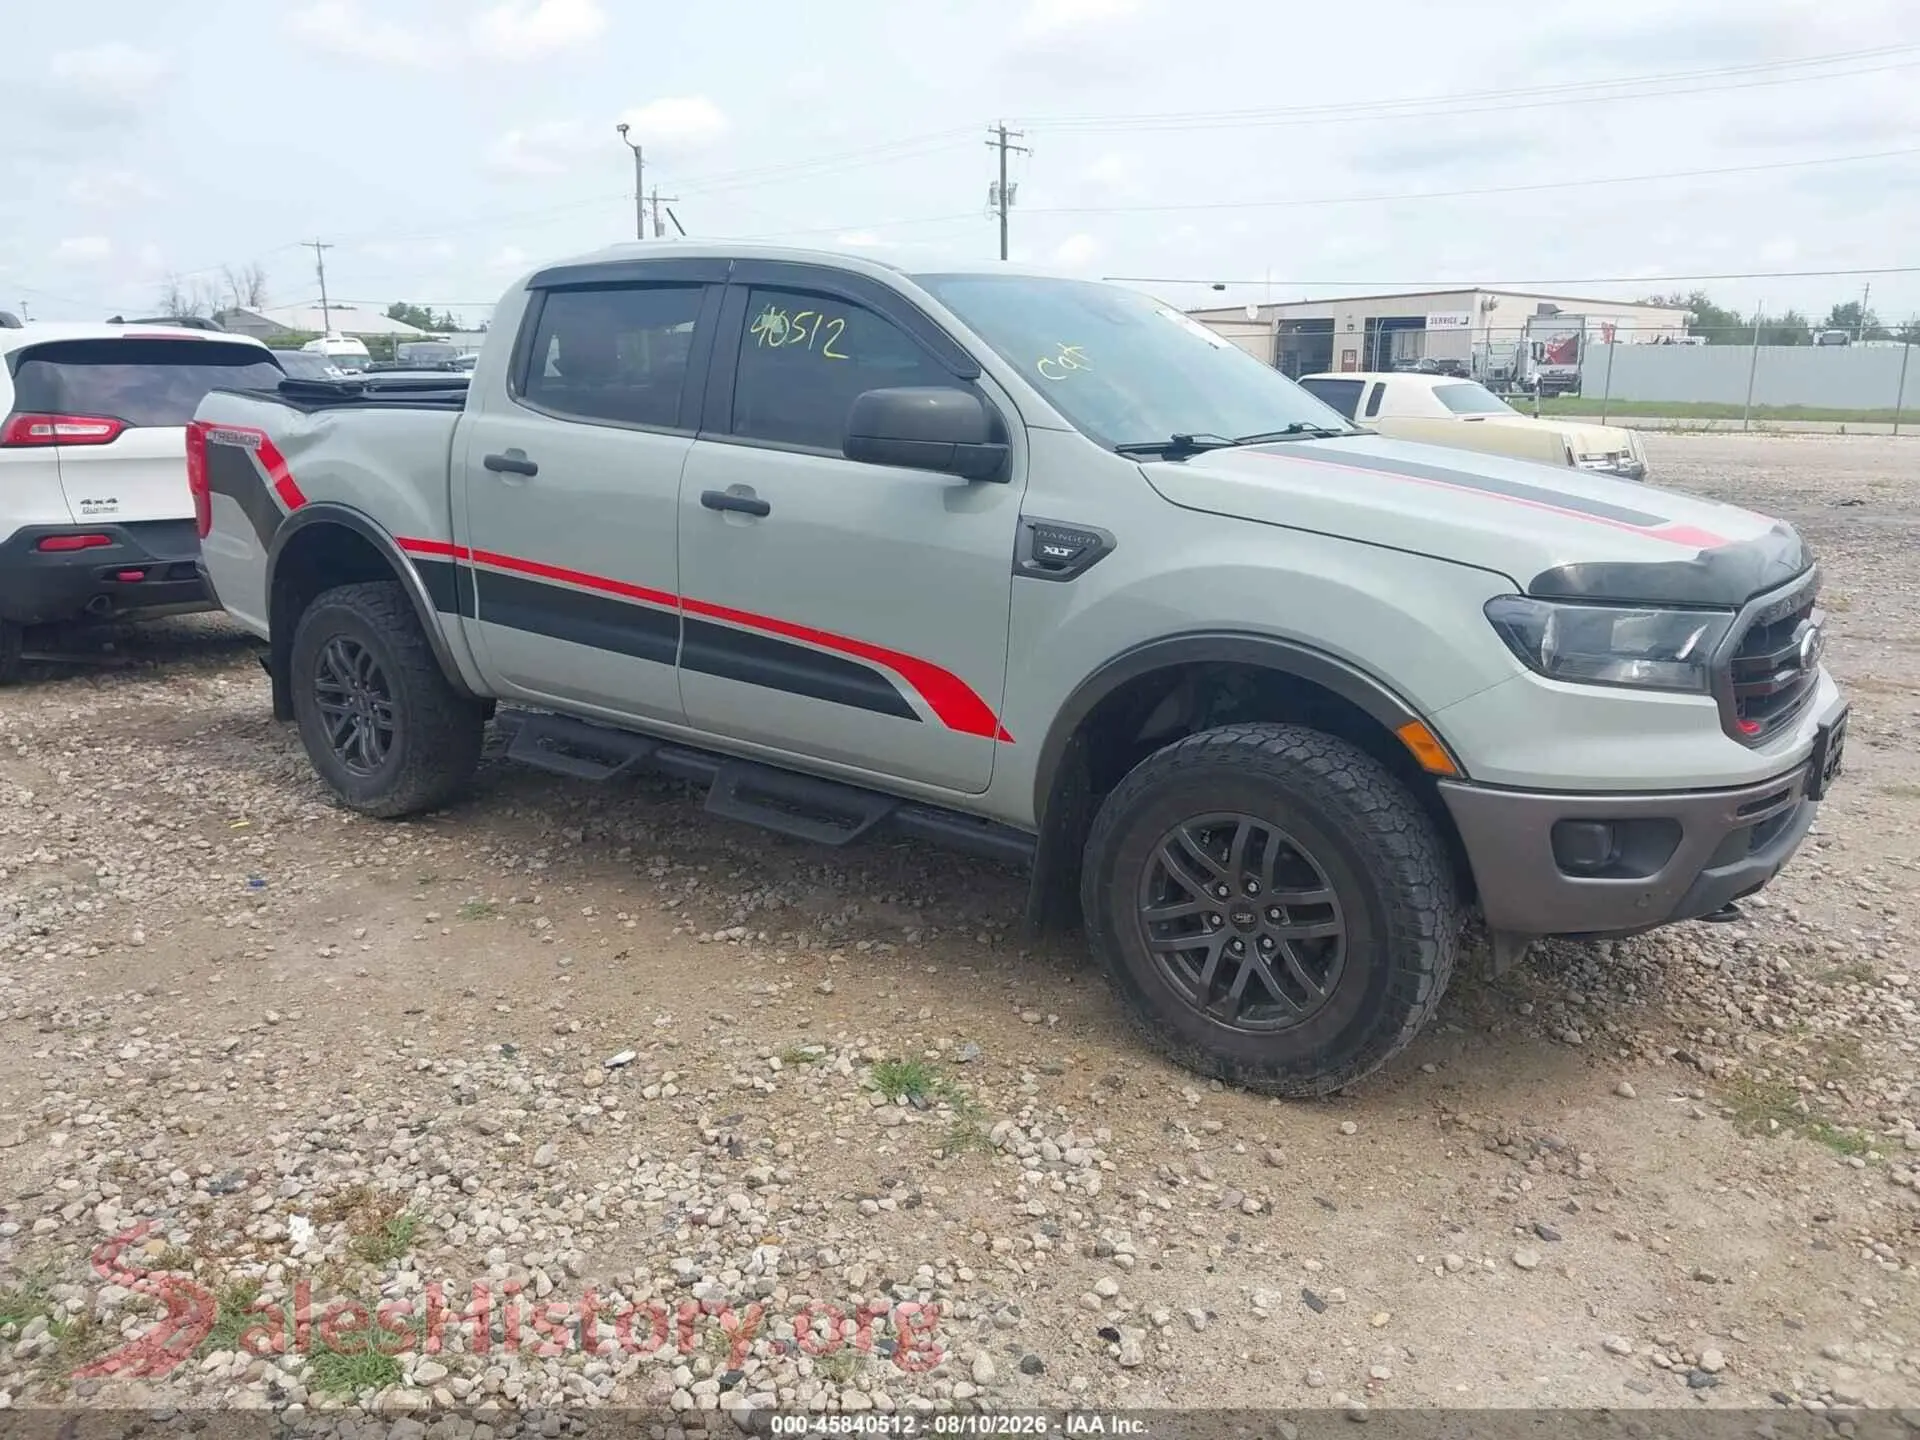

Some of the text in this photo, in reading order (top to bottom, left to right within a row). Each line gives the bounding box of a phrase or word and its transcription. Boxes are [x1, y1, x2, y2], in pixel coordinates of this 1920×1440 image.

[750, 304, 849, 359] 40512
[211, 430, 260, 447] TREMOR
[1043, 545, 1073, 556] XLT
